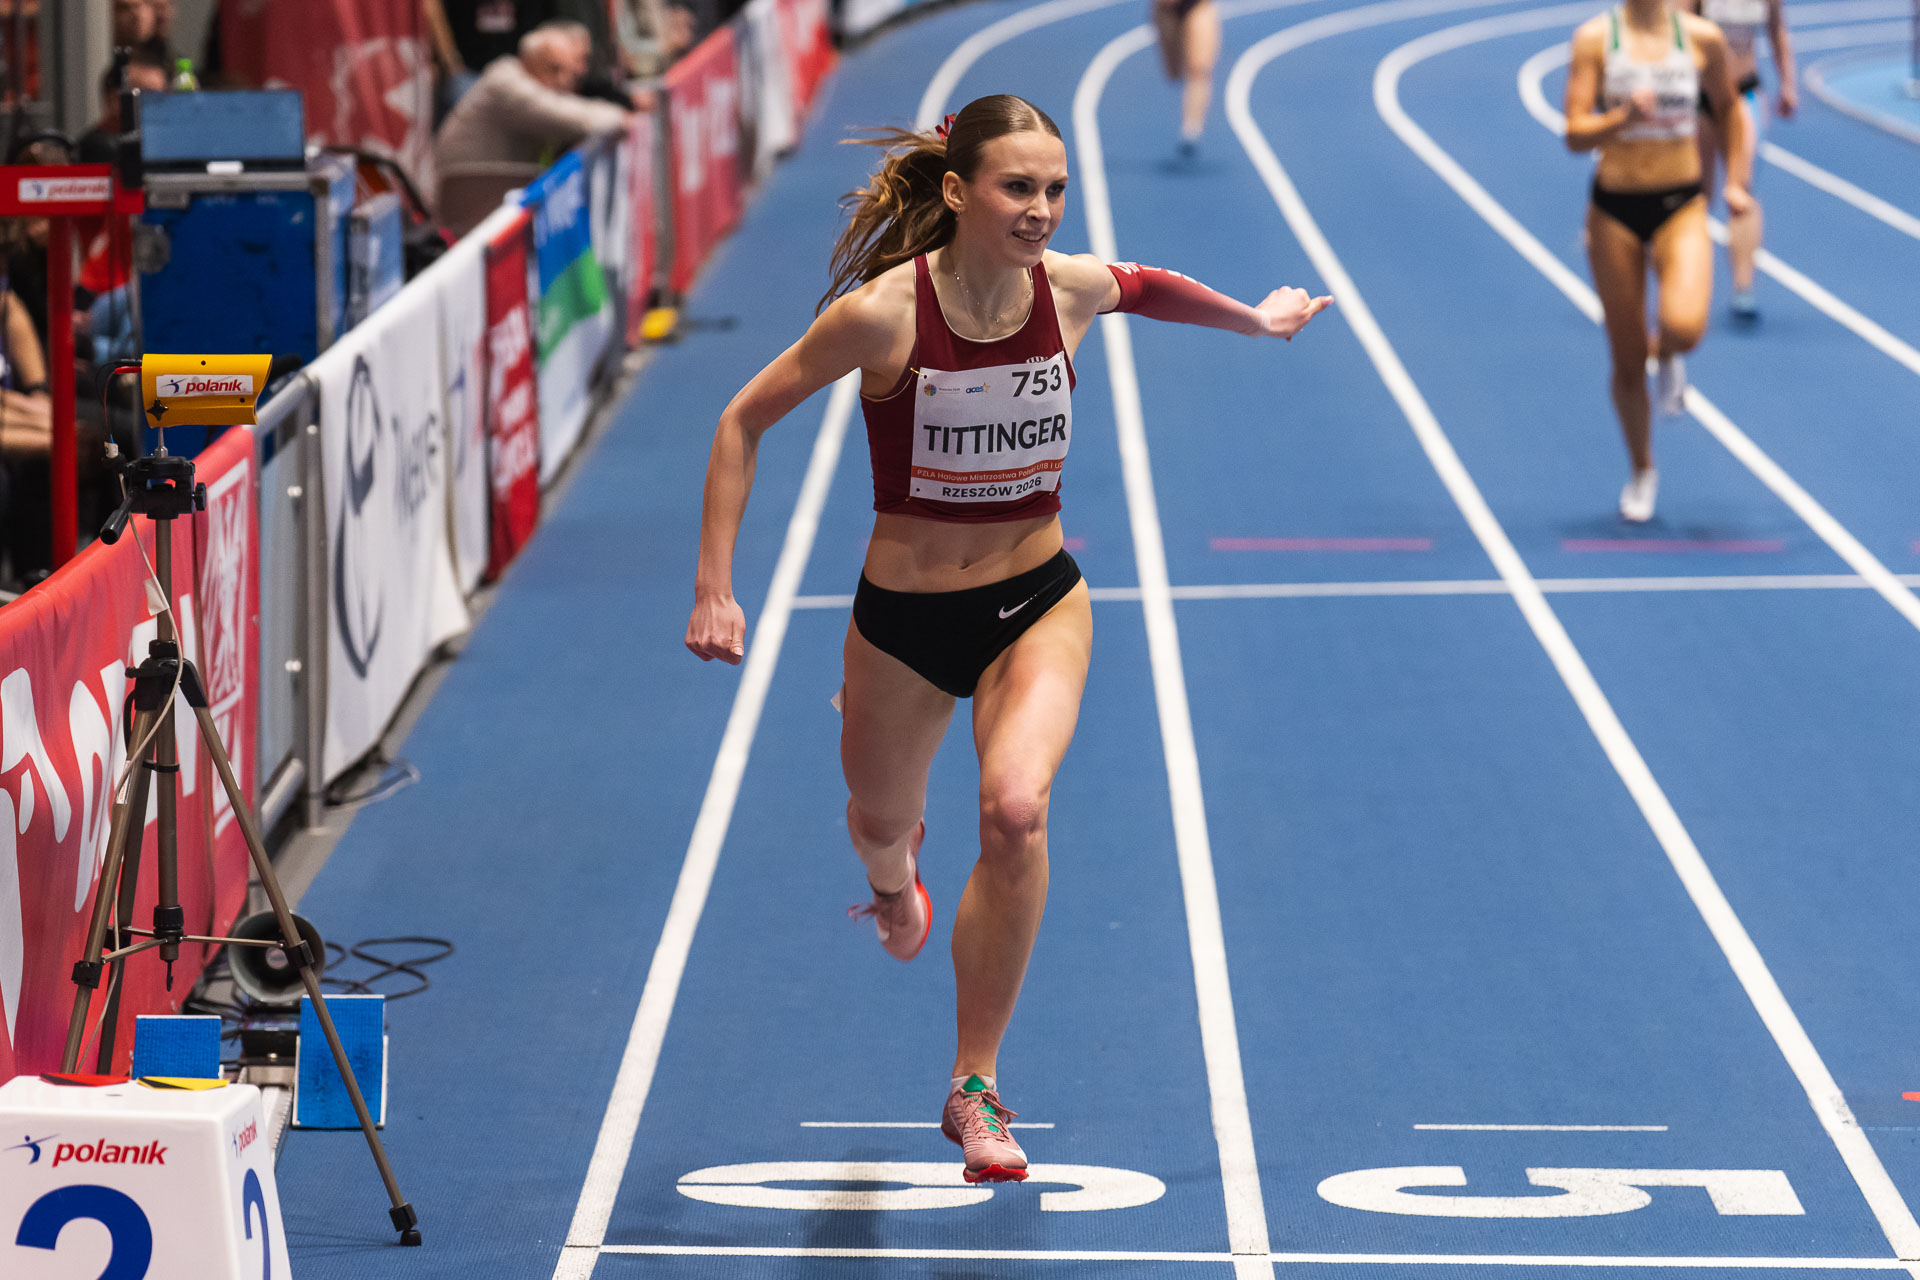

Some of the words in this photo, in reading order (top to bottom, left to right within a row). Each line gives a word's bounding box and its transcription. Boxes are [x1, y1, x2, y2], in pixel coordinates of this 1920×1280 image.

[185, 379, 243, 395] polanik
[1011, 364, 1062, 398] 753
[923, 413, 1067, 455] TITTINGER
[917, 469, 937, 479] PZLA
[937, 472, 968, 482] Halowe
[969, 471, 1017, 481] Mistrzostwa
[942, 484, 1013, 498] RZESZÓW
[1016, 476, 1042, 495] 2026
[52, 1138, 168, 1168] polanik
[1317, 1166, 1805, 1218] 5
